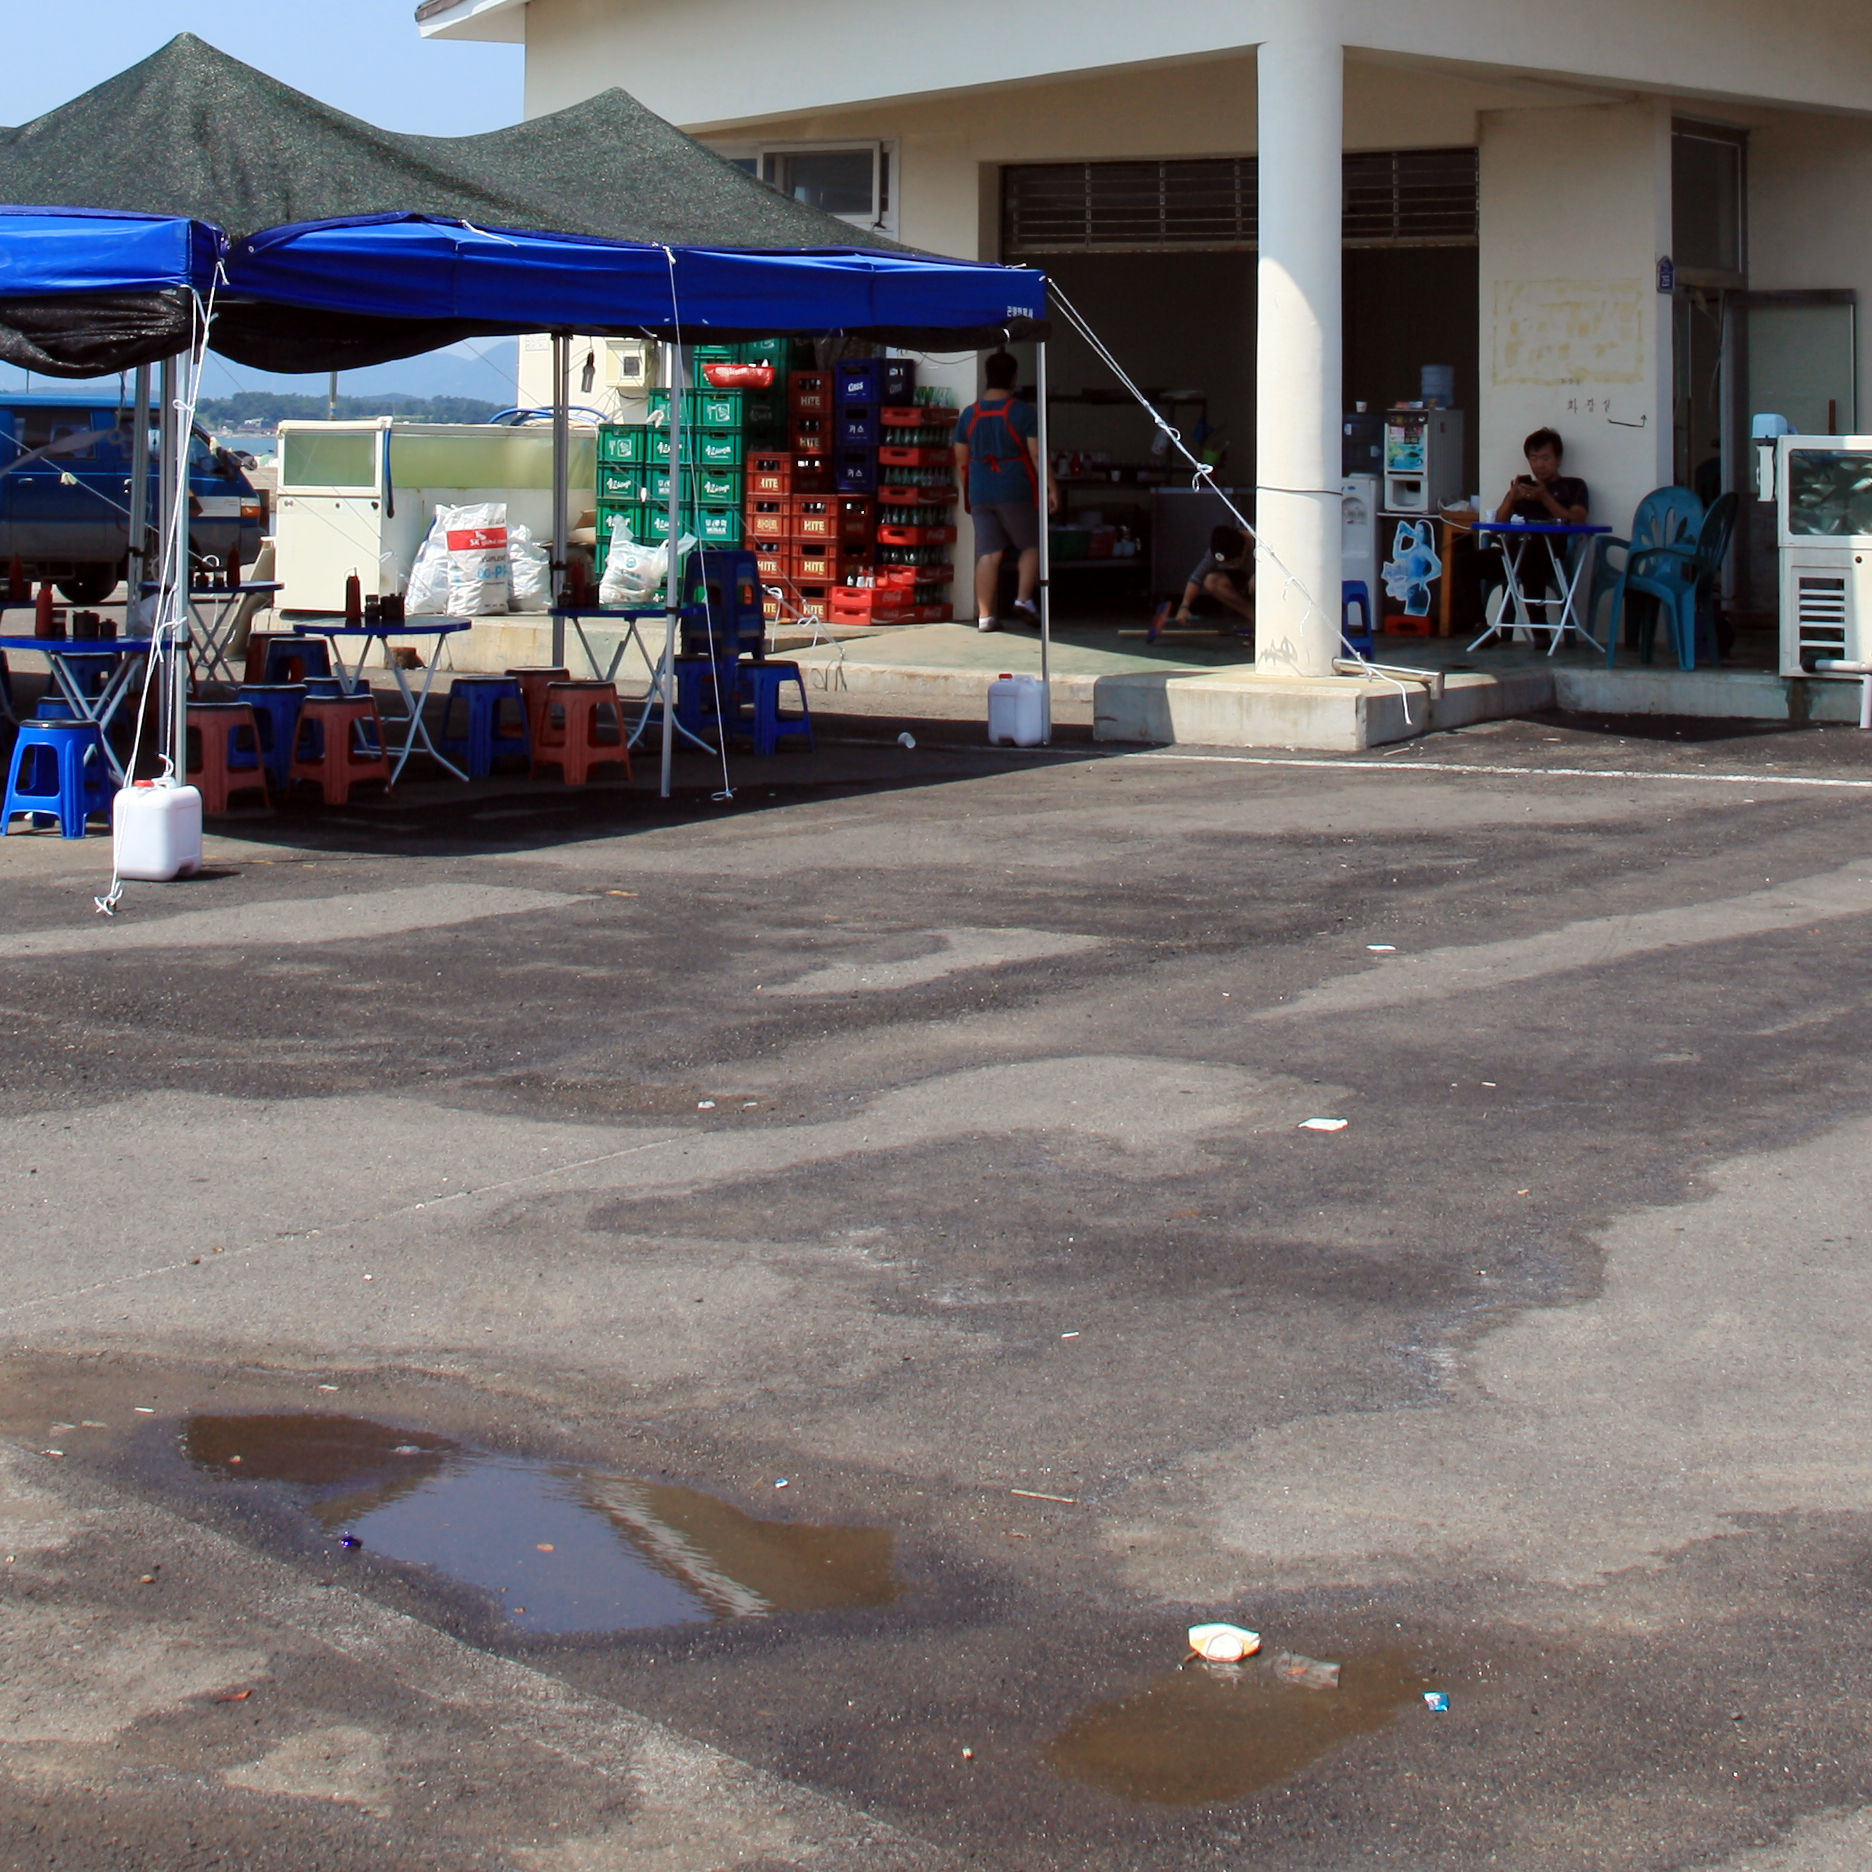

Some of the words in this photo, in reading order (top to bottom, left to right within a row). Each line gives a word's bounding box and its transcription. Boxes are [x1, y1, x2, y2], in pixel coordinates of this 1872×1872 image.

[800, 396, 821, 406] HITE
[799, 437, 820, 447] HITE
[804, 520, 825, 531] HITE
[758, 561, 777, 572] HITE
[804, 561, 825, 572] HITE
[803, 604, 824, 615] HITE
